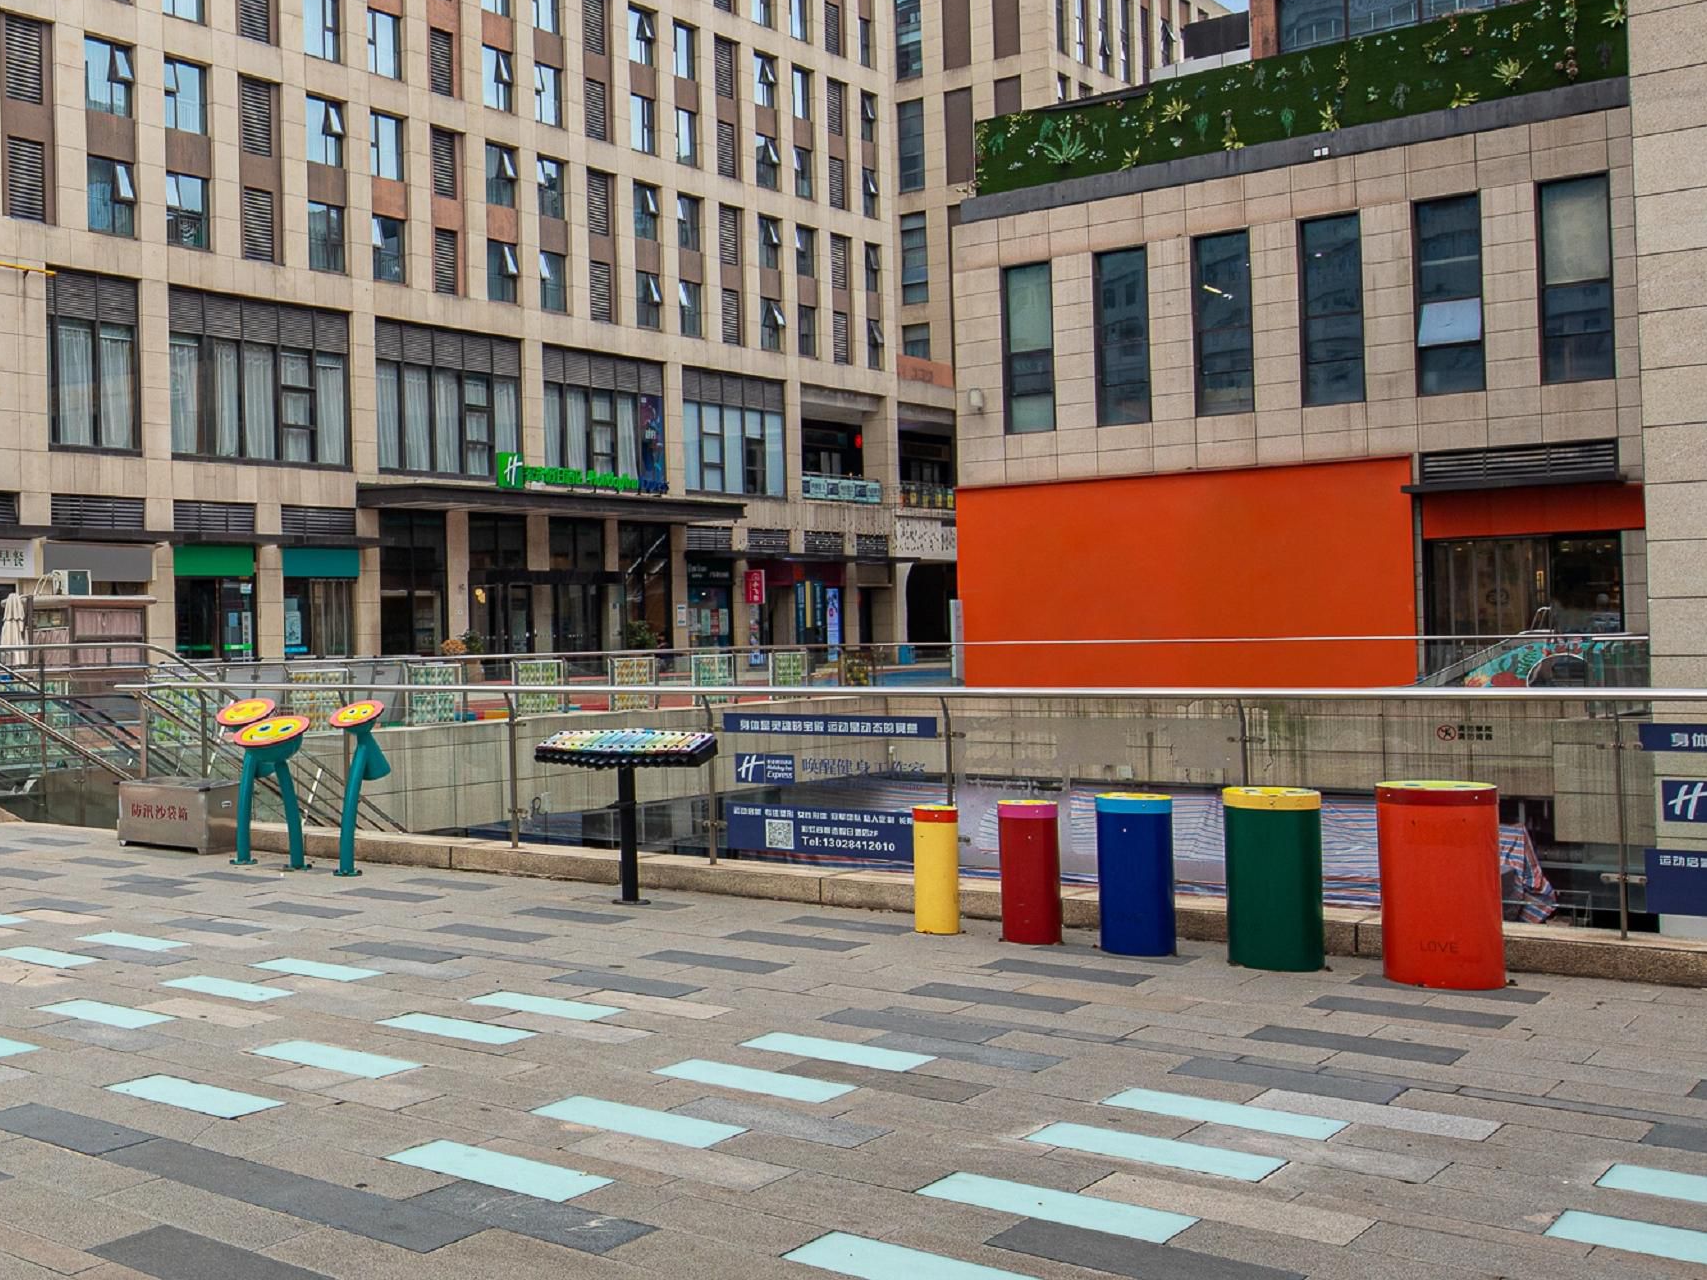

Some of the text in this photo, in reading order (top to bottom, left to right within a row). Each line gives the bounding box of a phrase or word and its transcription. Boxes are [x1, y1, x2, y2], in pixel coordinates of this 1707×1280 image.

[767, 771, 793, 779] Express
[131, 803, 188, 821] 防汛沙袋箱
[801, 836, 896, 852] Tel:13028412010
